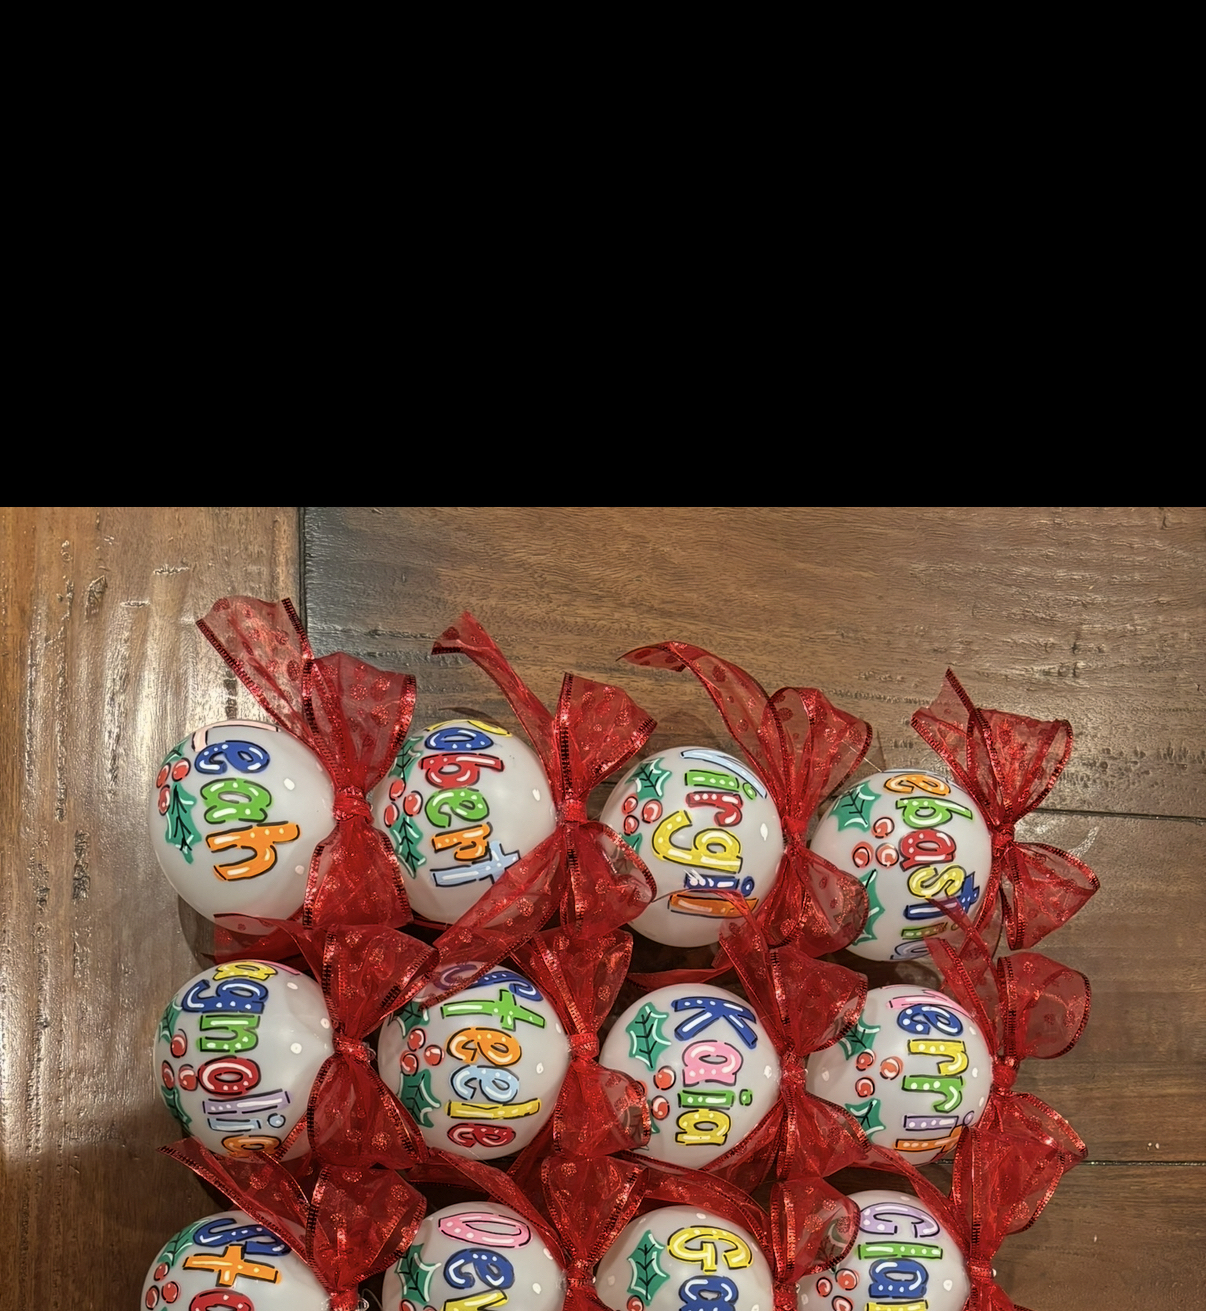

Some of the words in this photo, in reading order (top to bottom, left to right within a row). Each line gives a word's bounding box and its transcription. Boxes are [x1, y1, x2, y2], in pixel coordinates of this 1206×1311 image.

[191, 719, 300, 881] Leah
[418, 720, 521, 887] obert
[883, 769, 980, 961] ebasti
[182, 960, 299, 1158] agnolia
[434, 963, 545, 1148] Steele
[671, 996, 758, 1147] Kaia
[880, 986, 976, 1156] errit
